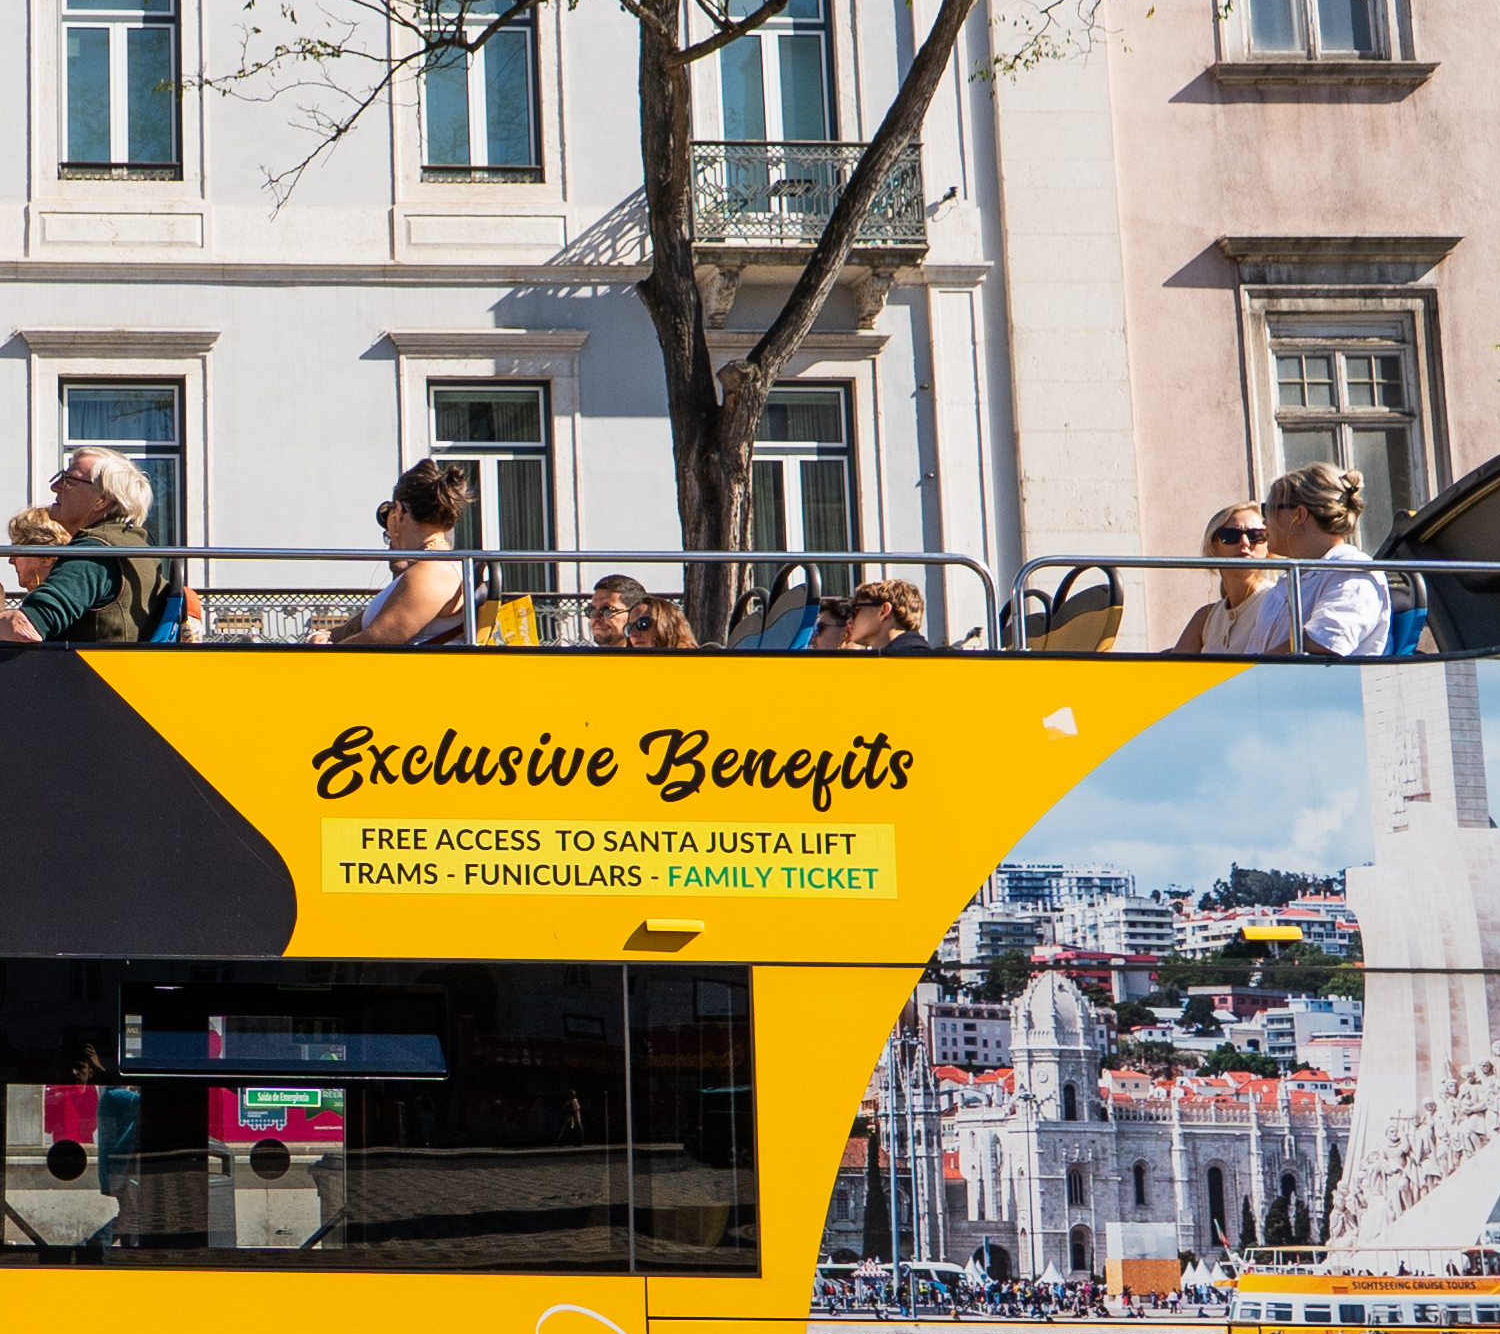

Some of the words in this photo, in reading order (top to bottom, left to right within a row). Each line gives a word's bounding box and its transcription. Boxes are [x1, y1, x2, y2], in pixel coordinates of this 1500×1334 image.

[311, 725, 619, 800] Exclusive
[638, 728, 914, 813] Benefits
[361, 828, 428, 851] FREE
[436, 829, 541, 852] ACCESS
[555, 830, 595, 852] TO
[603, 830, 699, 854] SANTA
[705, 831, 793, 854] JUSTA
[801, 832, 857, 855] LIFT
[339, 862, 438, 886] TRAMS
[465, 863, 642, 887] FUNICULARS
[668, 865, 772, 889] FAMILY
[781, 866, 878, 889] TICKET
[1352, 1281, 1410, 1291] SIGHTSEEING
[1413, 1281, 1444, 1291] CRUISE
[1447, 1281, 1477, 1291] TOURS
